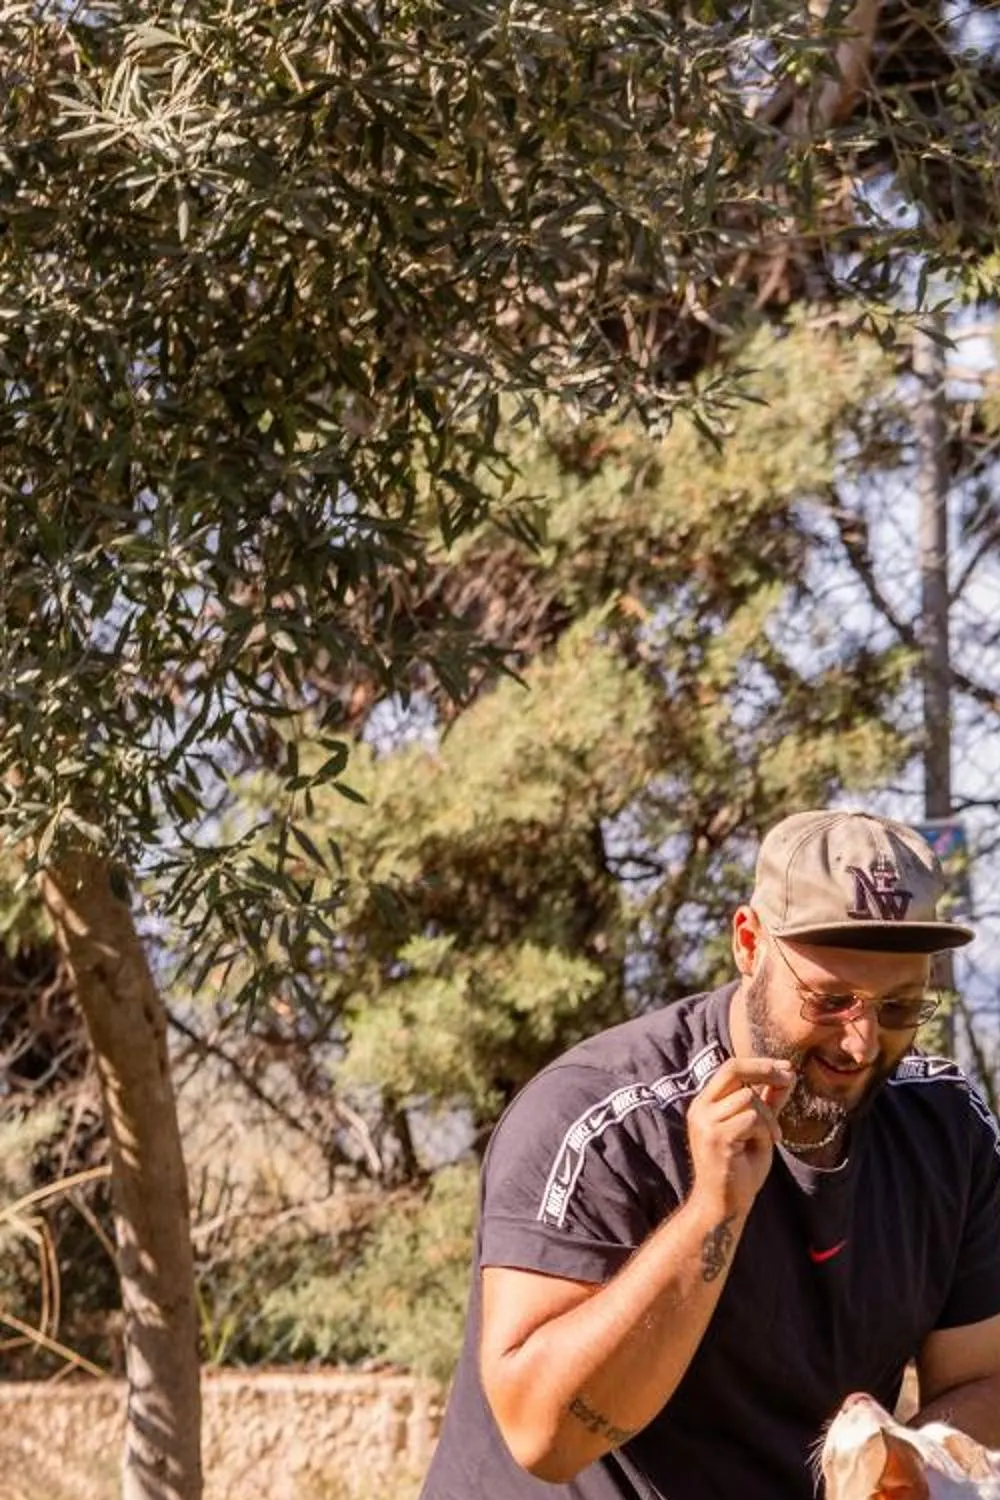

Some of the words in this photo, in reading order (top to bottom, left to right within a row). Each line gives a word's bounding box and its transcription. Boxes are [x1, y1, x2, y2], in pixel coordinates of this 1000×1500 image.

[611, 1089, 641, 1117] NIKE
[566, 1121, 593, 1154] NIKE
[545, 1182, 567, 1217] NIKE
